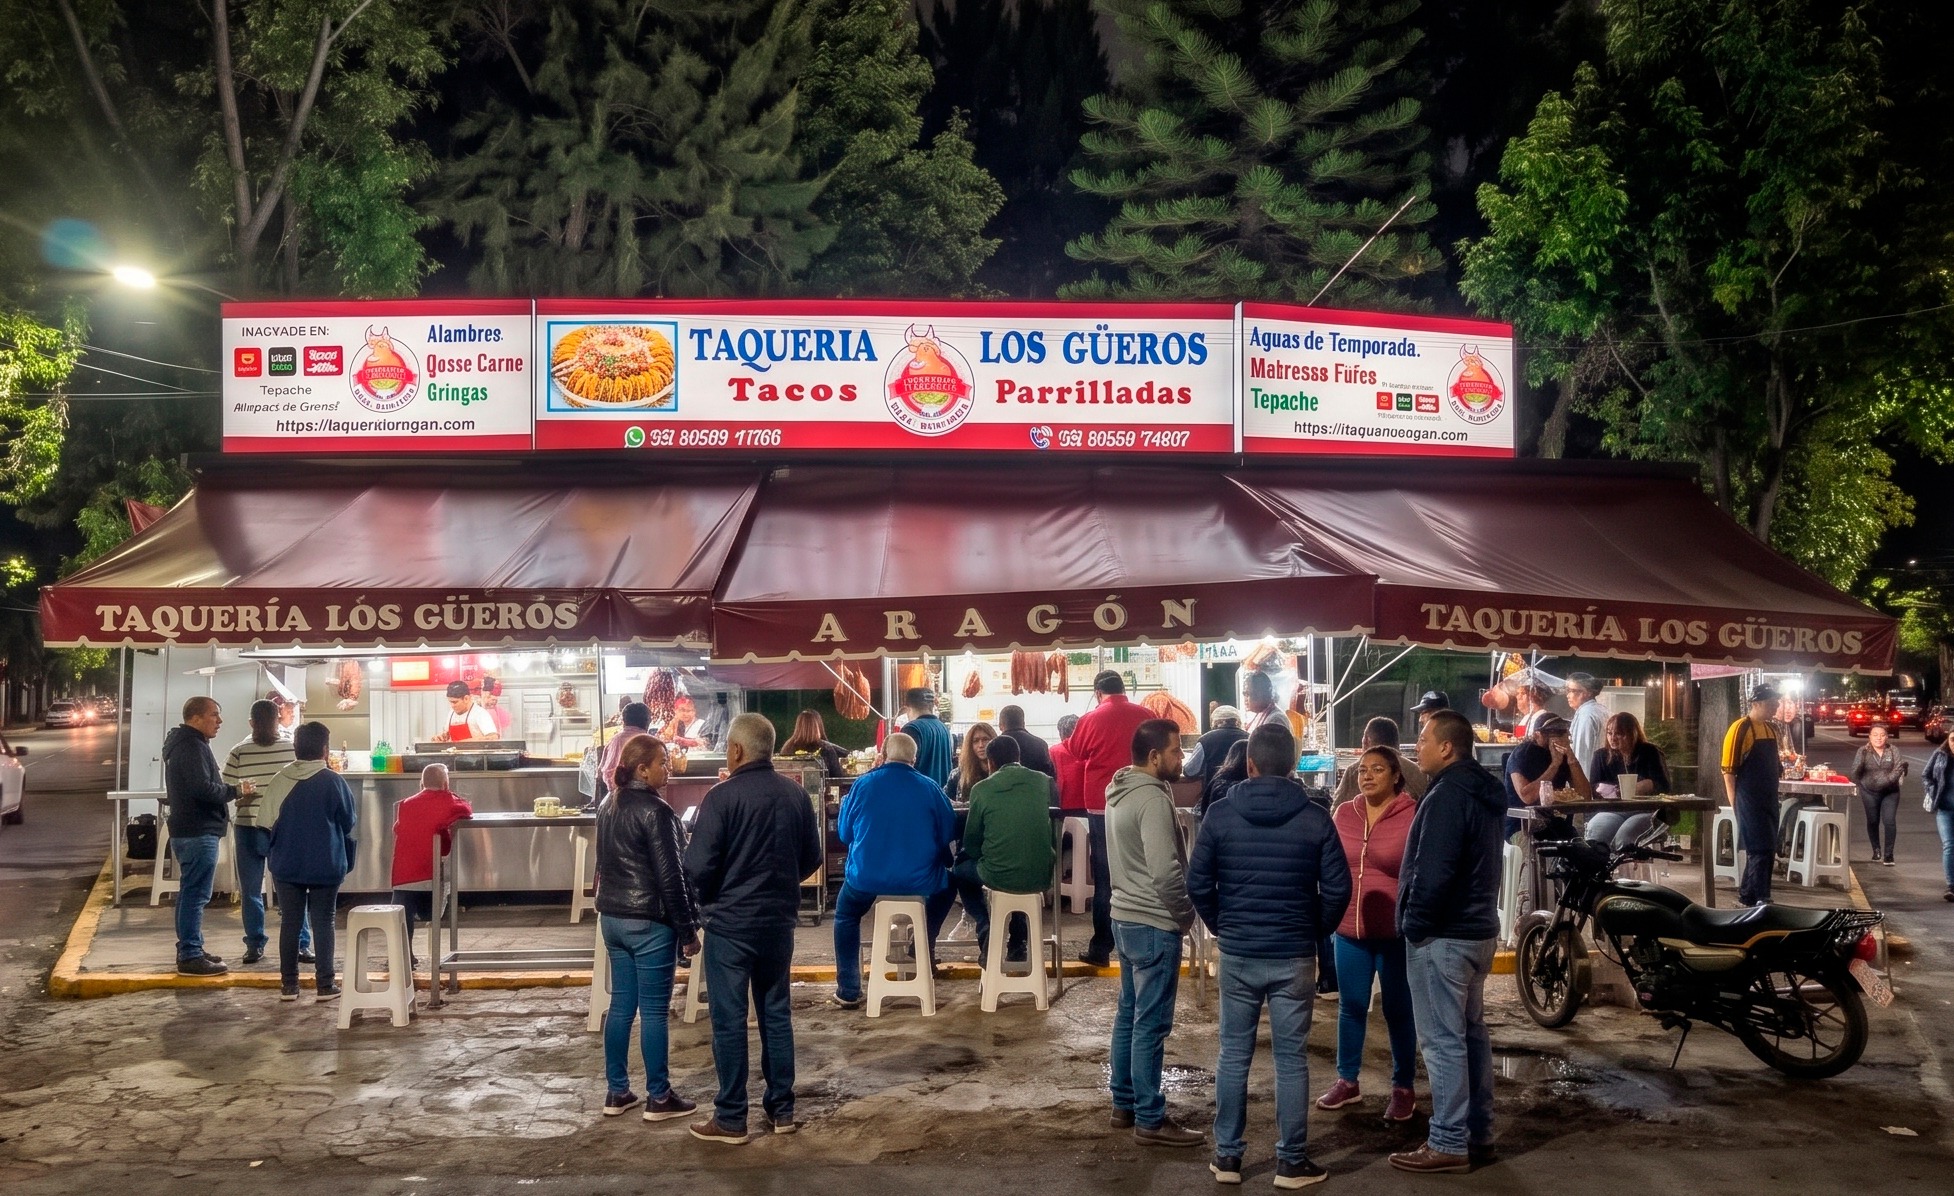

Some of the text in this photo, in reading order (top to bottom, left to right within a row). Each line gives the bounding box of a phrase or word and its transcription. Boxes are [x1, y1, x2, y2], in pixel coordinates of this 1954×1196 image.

[309, 325, 330, 336] EN:
[1249, 326, 1422, 360] Aguas de Temporada.
[688, 323, 1209, 373] TAQUERIA LOS GÜEROS
[477, 353, 524, 373] Carne
[259, 385, 312, 397] Tepache
[427, 382, 489, 407] Gringas
[727, 377, 1192, 405] Tacos Parrilladas
[1250, 387, 1319, 415] Tepache
[282, 402, 297, 412] de
[95, 596, 312, 638] TAQUERÍA
[413, 594, 579, 630] GÜEROS
[810, 594, 1199, 643] ARAGÓN
[1420, 602, 1864, 655] TAQUERÍA LOS GÜEROS
